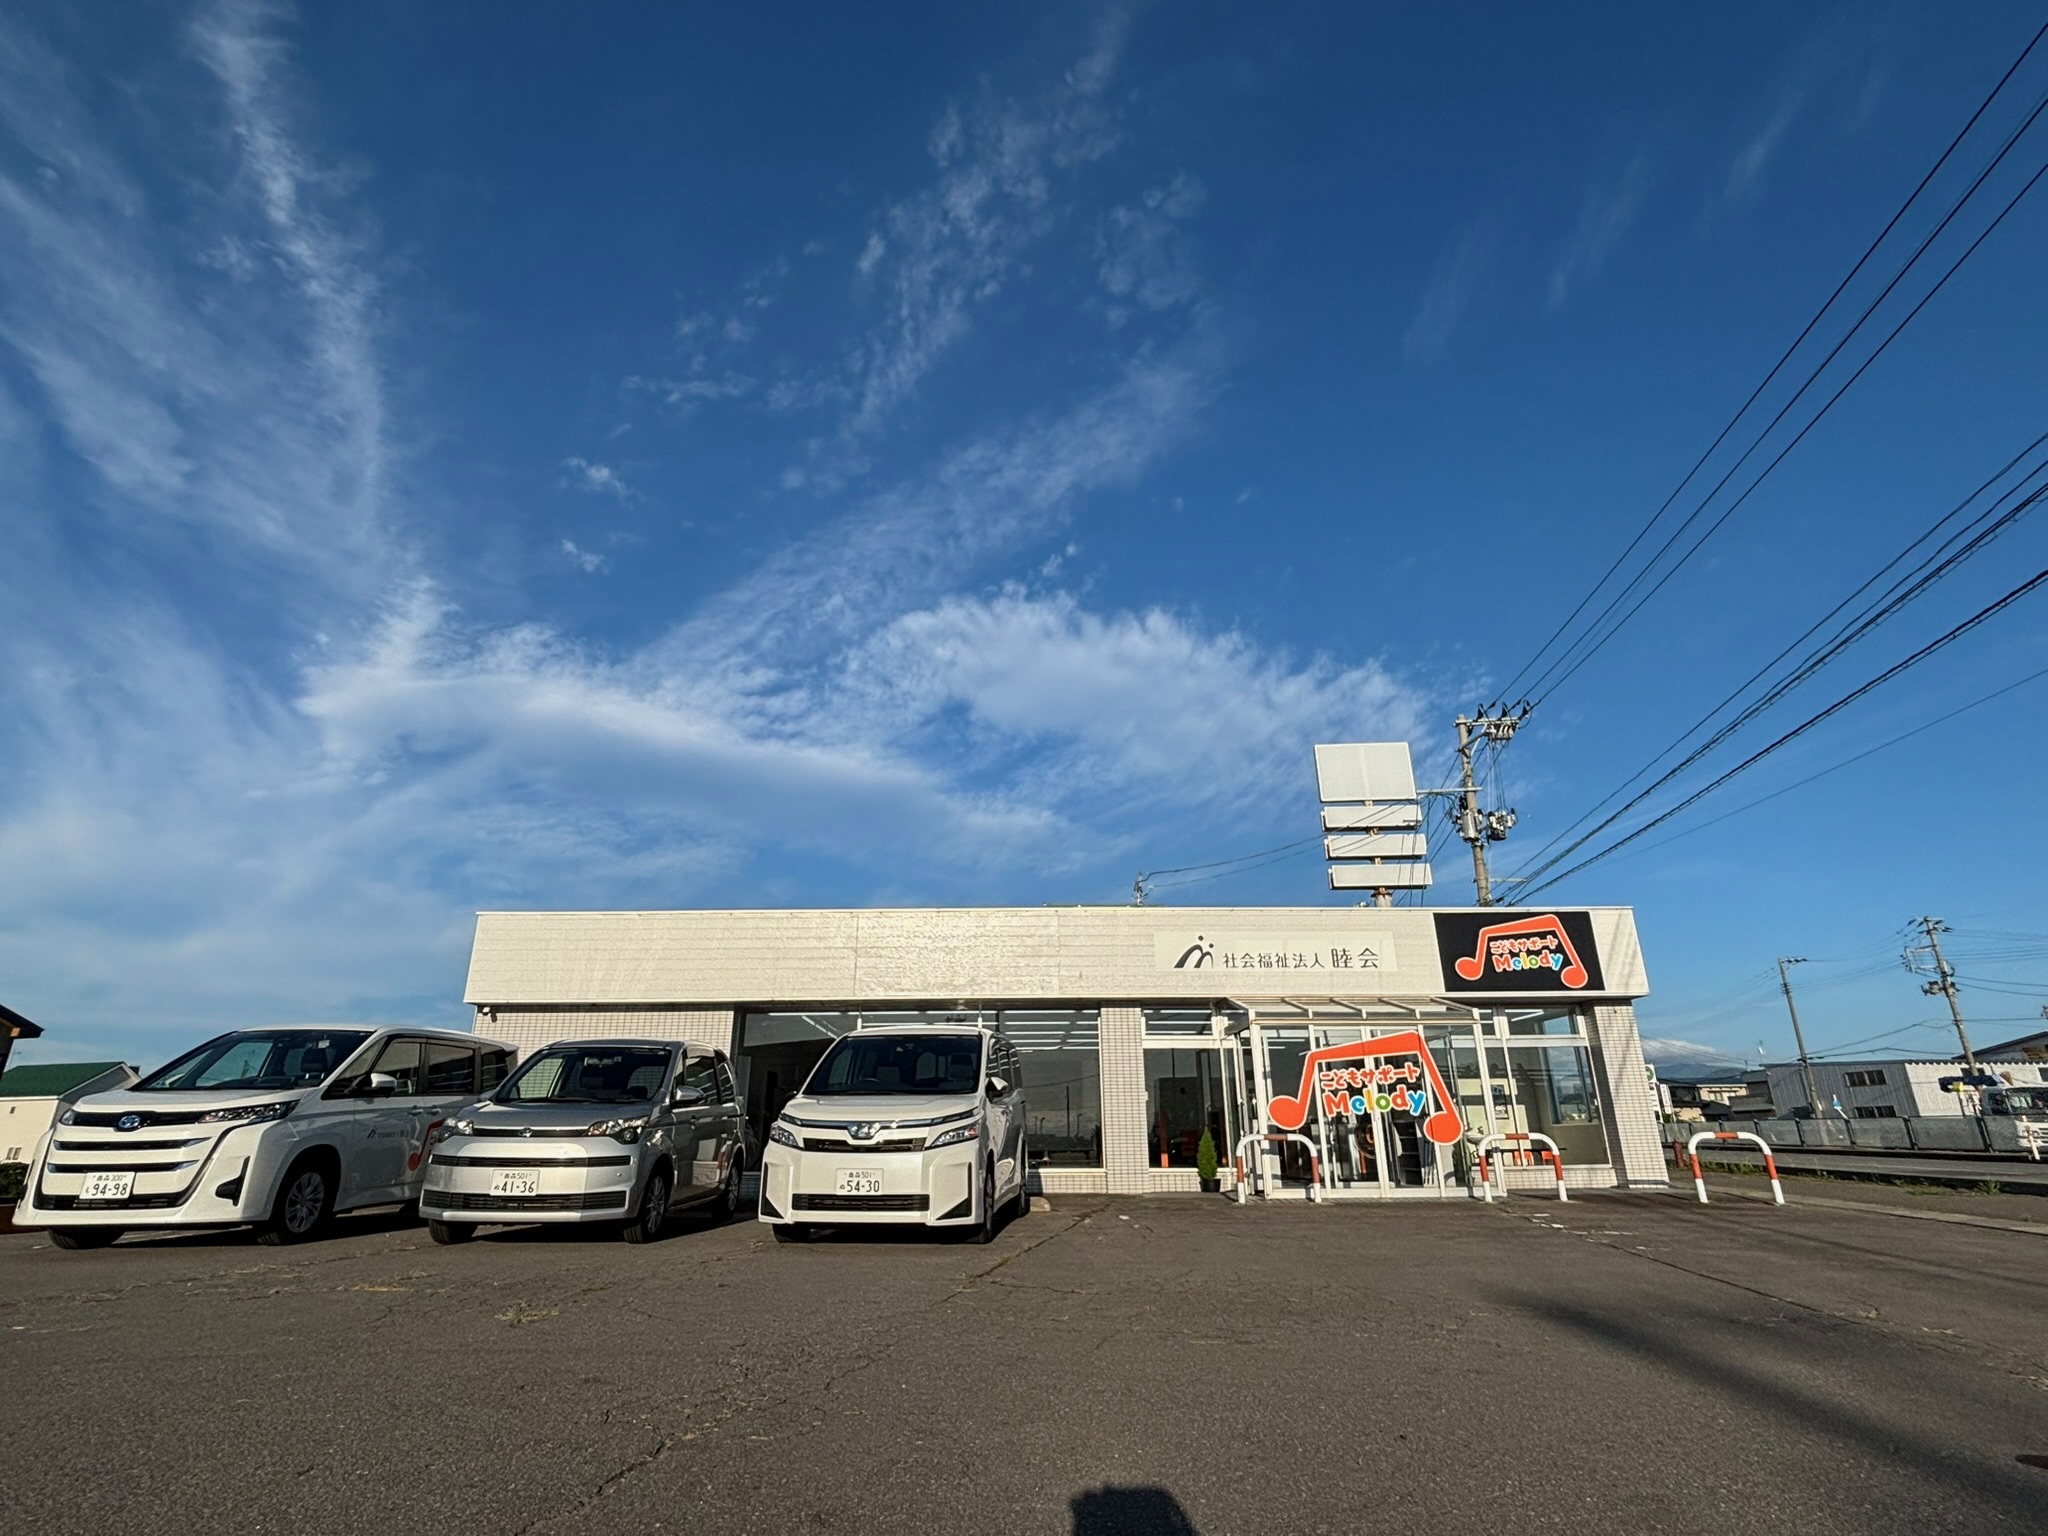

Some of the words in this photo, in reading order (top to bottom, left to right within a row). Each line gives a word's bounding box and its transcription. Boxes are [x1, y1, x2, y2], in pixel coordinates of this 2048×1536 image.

[1490, 935, 1558, 954] こどもサポート
[1492, 950, 1563, 972] Melody
[1320, 1063, 1420, 1090] こどもサポート
[1322, 1084, 1426, 1117] Melody
[91, 1183, 128, 1196] 94-98
[501, 1181, 535, 1193] 41-36
[846, 1180, 880, 1193] 54-30
